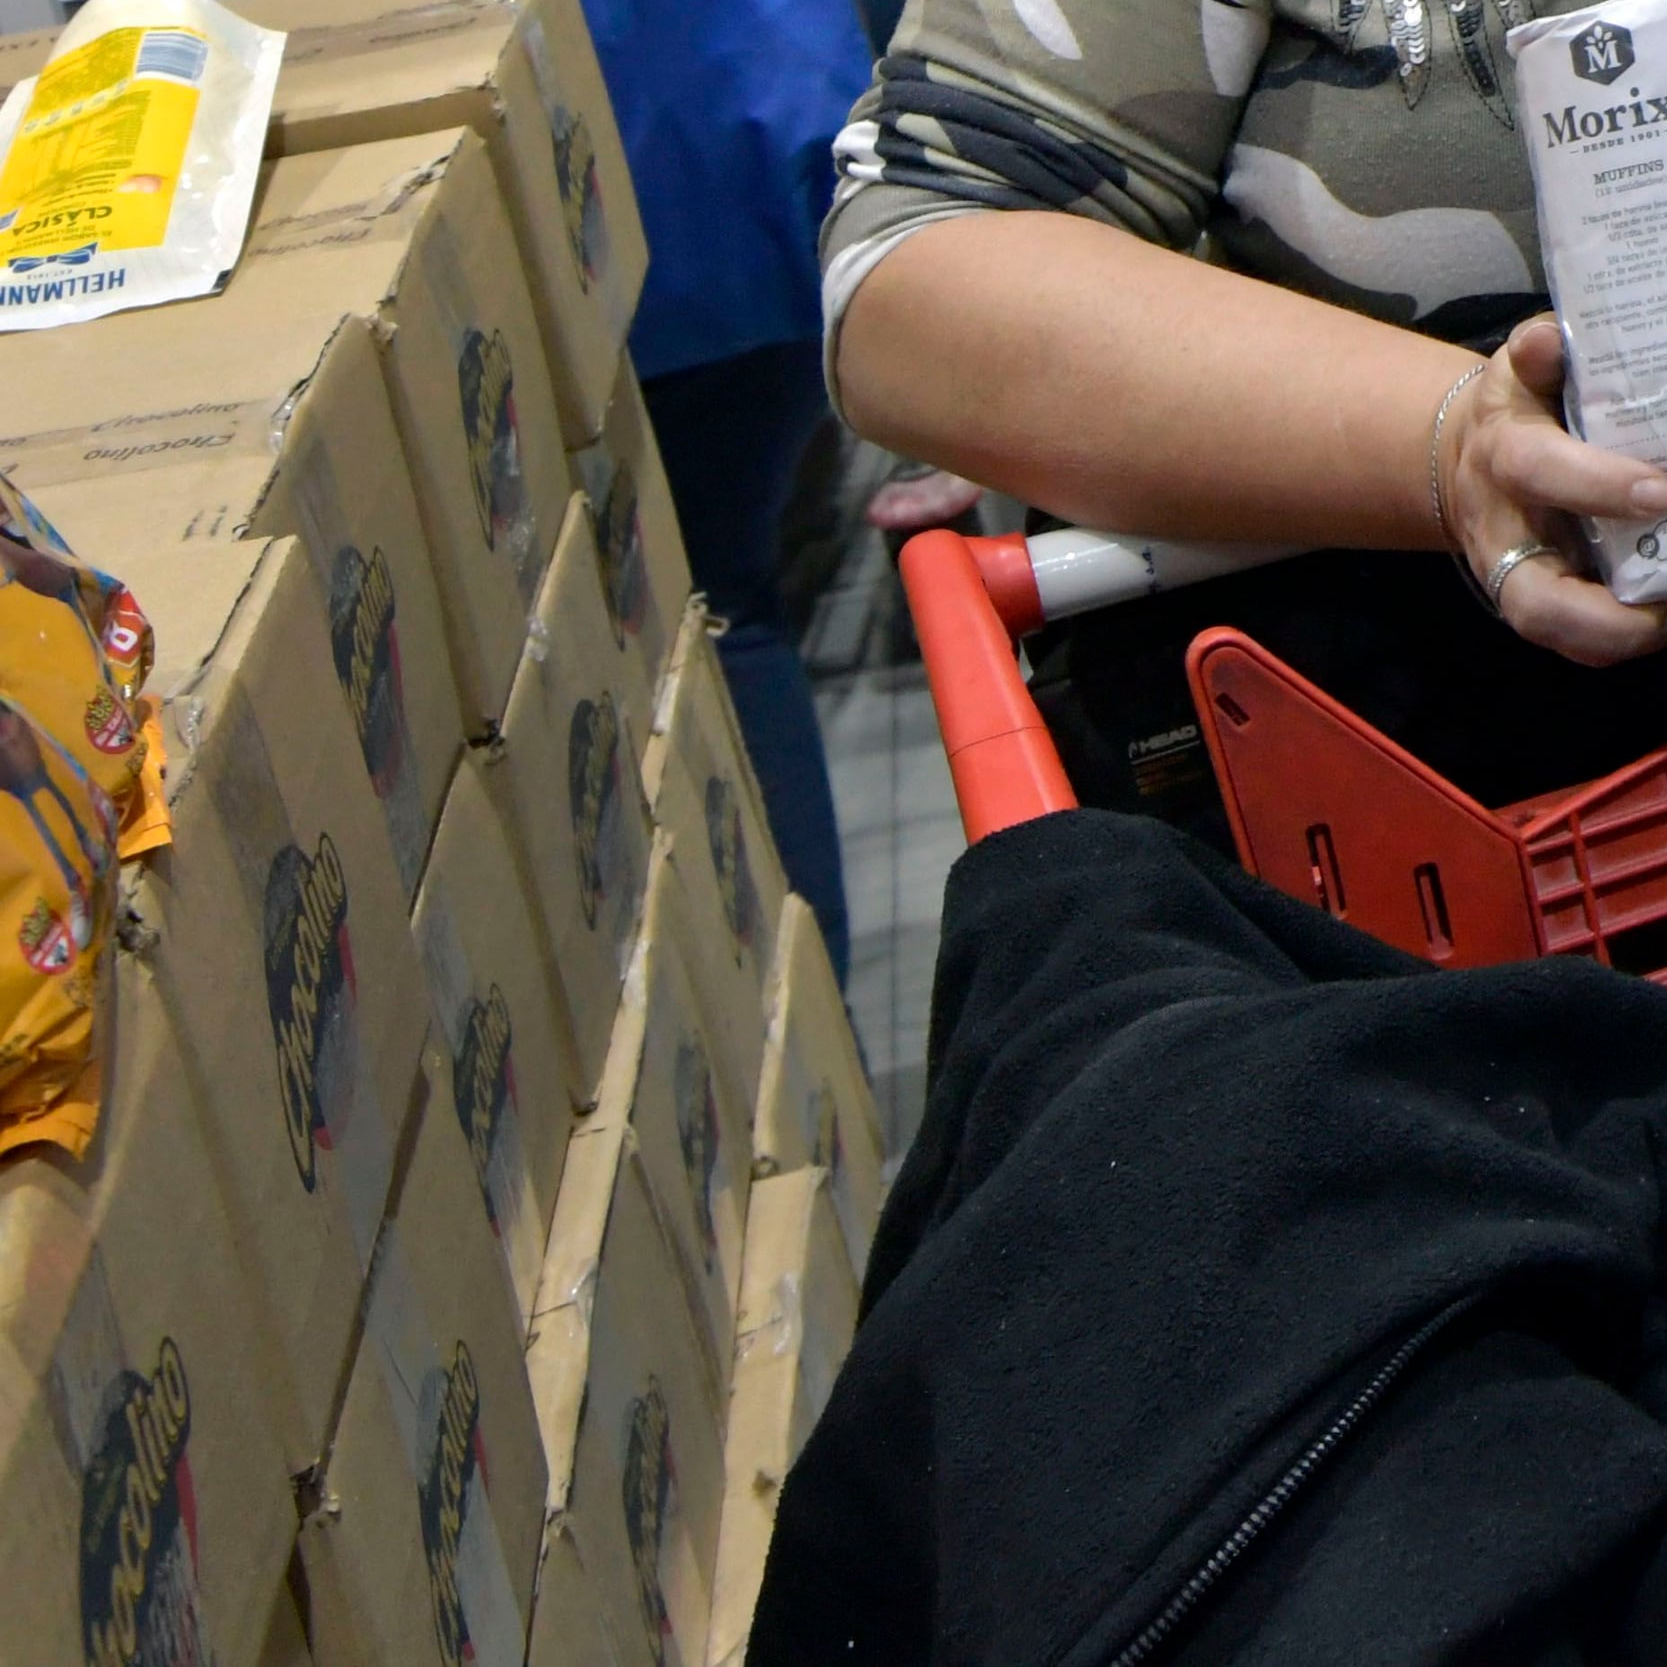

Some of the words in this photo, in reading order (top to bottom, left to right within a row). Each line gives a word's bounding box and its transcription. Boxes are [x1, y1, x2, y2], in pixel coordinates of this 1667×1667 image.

[1582, 136, 1624, 153] DESDE
[1629, 129, 1661, 142] 1901
[1592, 158, 1665, 185] MUFFINS
[13, 206, 112, 237] CLÁSICA
[277, 832, 347, 1193] Chocolino
